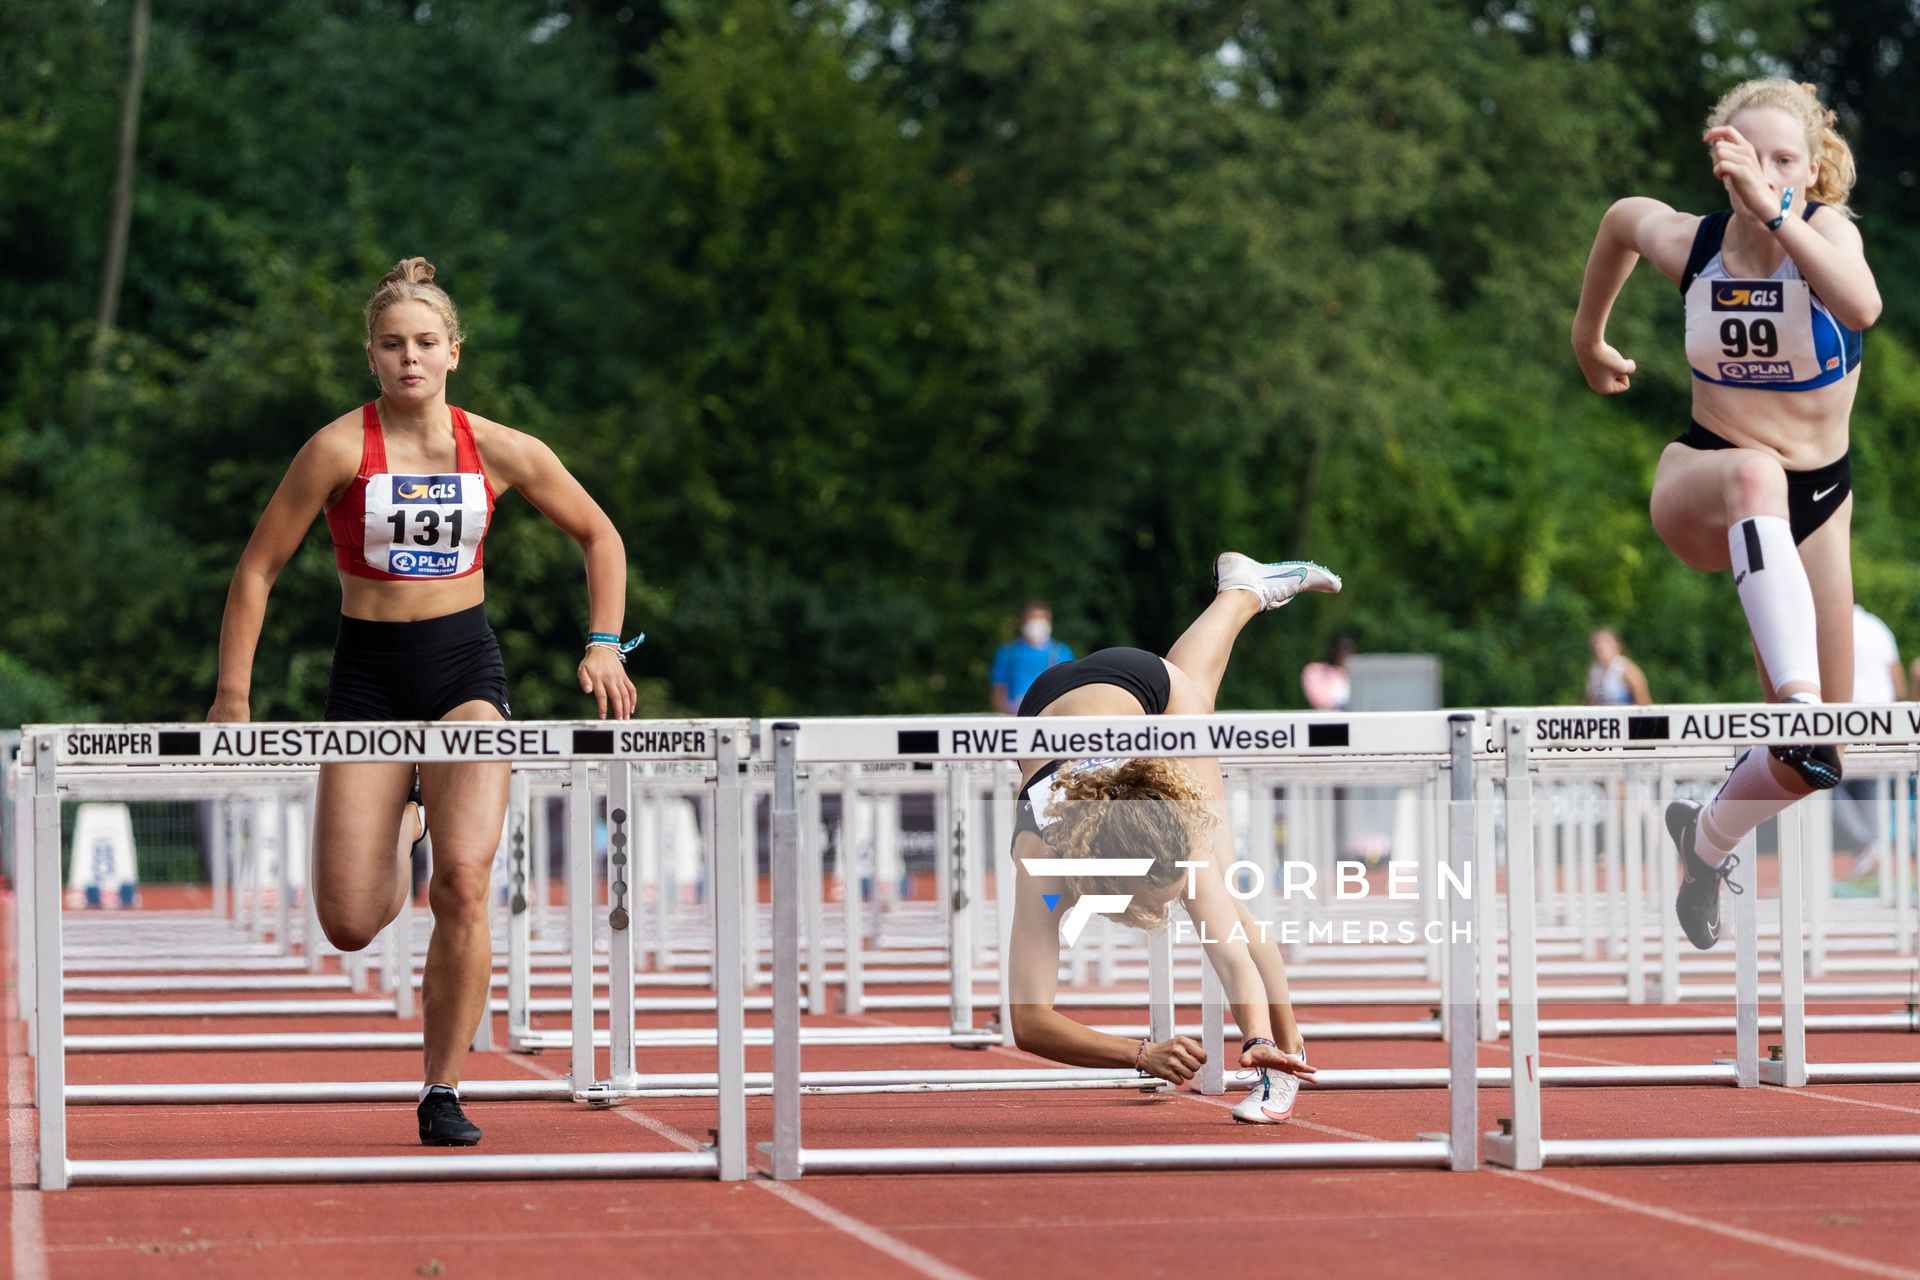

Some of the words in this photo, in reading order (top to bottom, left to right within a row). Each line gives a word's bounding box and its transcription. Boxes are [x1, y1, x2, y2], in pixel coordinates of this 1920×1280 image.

[1750, 290, 1777, 307] GLS
[1720, 318, 1779, 358] 99
[1748, 364, 1790, 375] PLAN
[428, 483, 457, 499] GLS
[387, 509, 463, 548] 131
[418, 555, 457, 568] PLAN
[951, 729, 1018, 754] RWE
[1029, 725, 1197, 754] Auestadion
[1207, 723, 1296, 750] Wesel
[1536, 717, 1621, 741] SCHÄPER
[1680, 710, 1892, 740] AUESTADION
[66, 732, 152, 756] SCHÄPER
[211, 728, 426, 757] AUESTADION
[440, 728, 561, 756] WESEL
[619, 730, 706, 754] SCHÄPER
